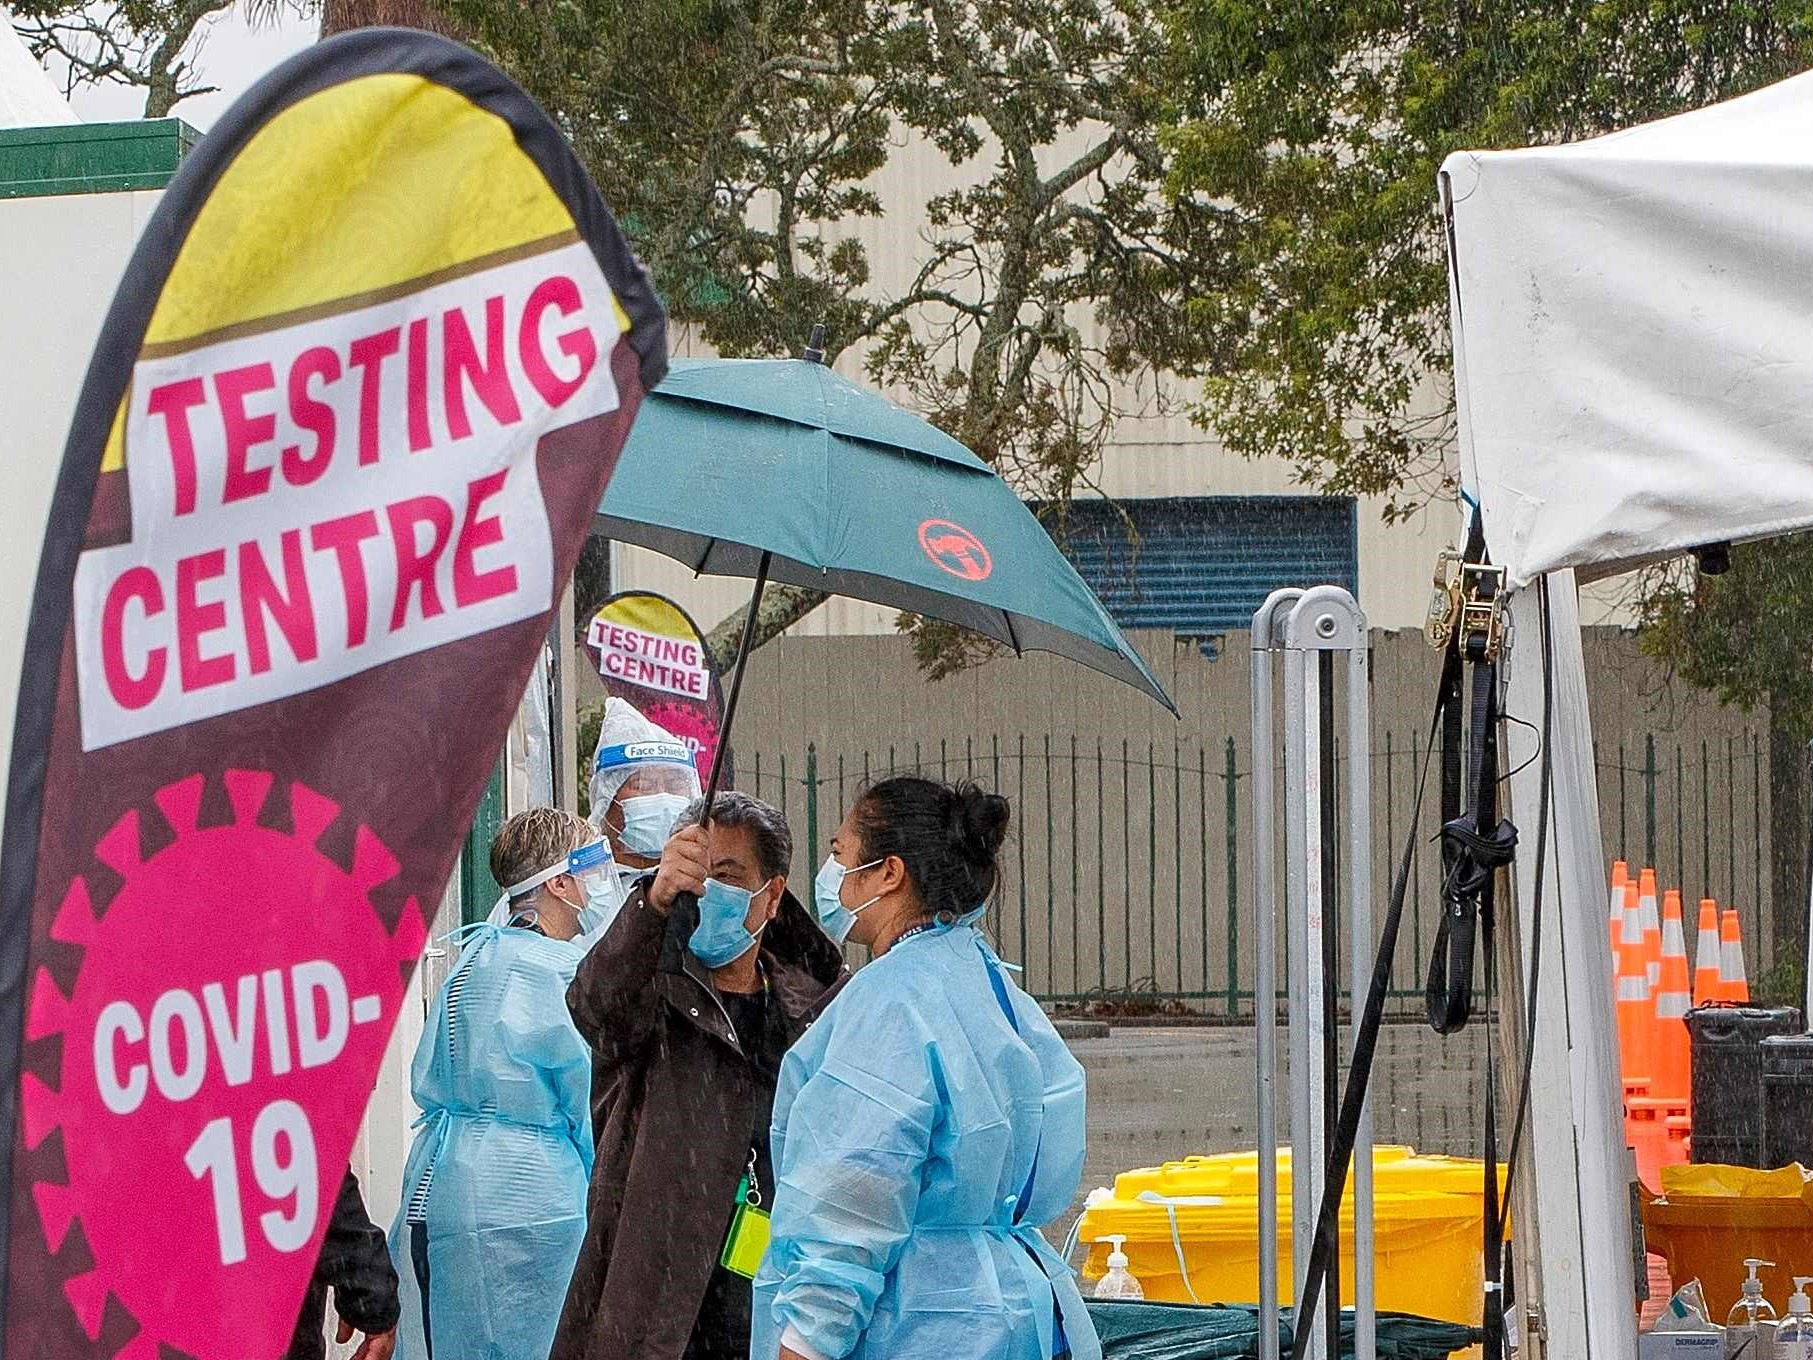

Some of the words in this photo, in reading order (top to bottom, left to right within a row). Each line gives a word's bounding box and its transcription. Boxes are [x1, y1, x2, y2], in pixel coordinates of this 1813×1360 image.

[147, 276, 597, 516] TESTING
[101, 469, 518, 710] CENTRE
[595, 622, 698, 667] TESTING
[605, 652, 701, 694] CENTRE
[630, 746, 655, 756] Face
[657, 745, 686, 758] Shield
[94, 961, 380, 1114] COVID-
[185, 1100, 318, 1265] 19
